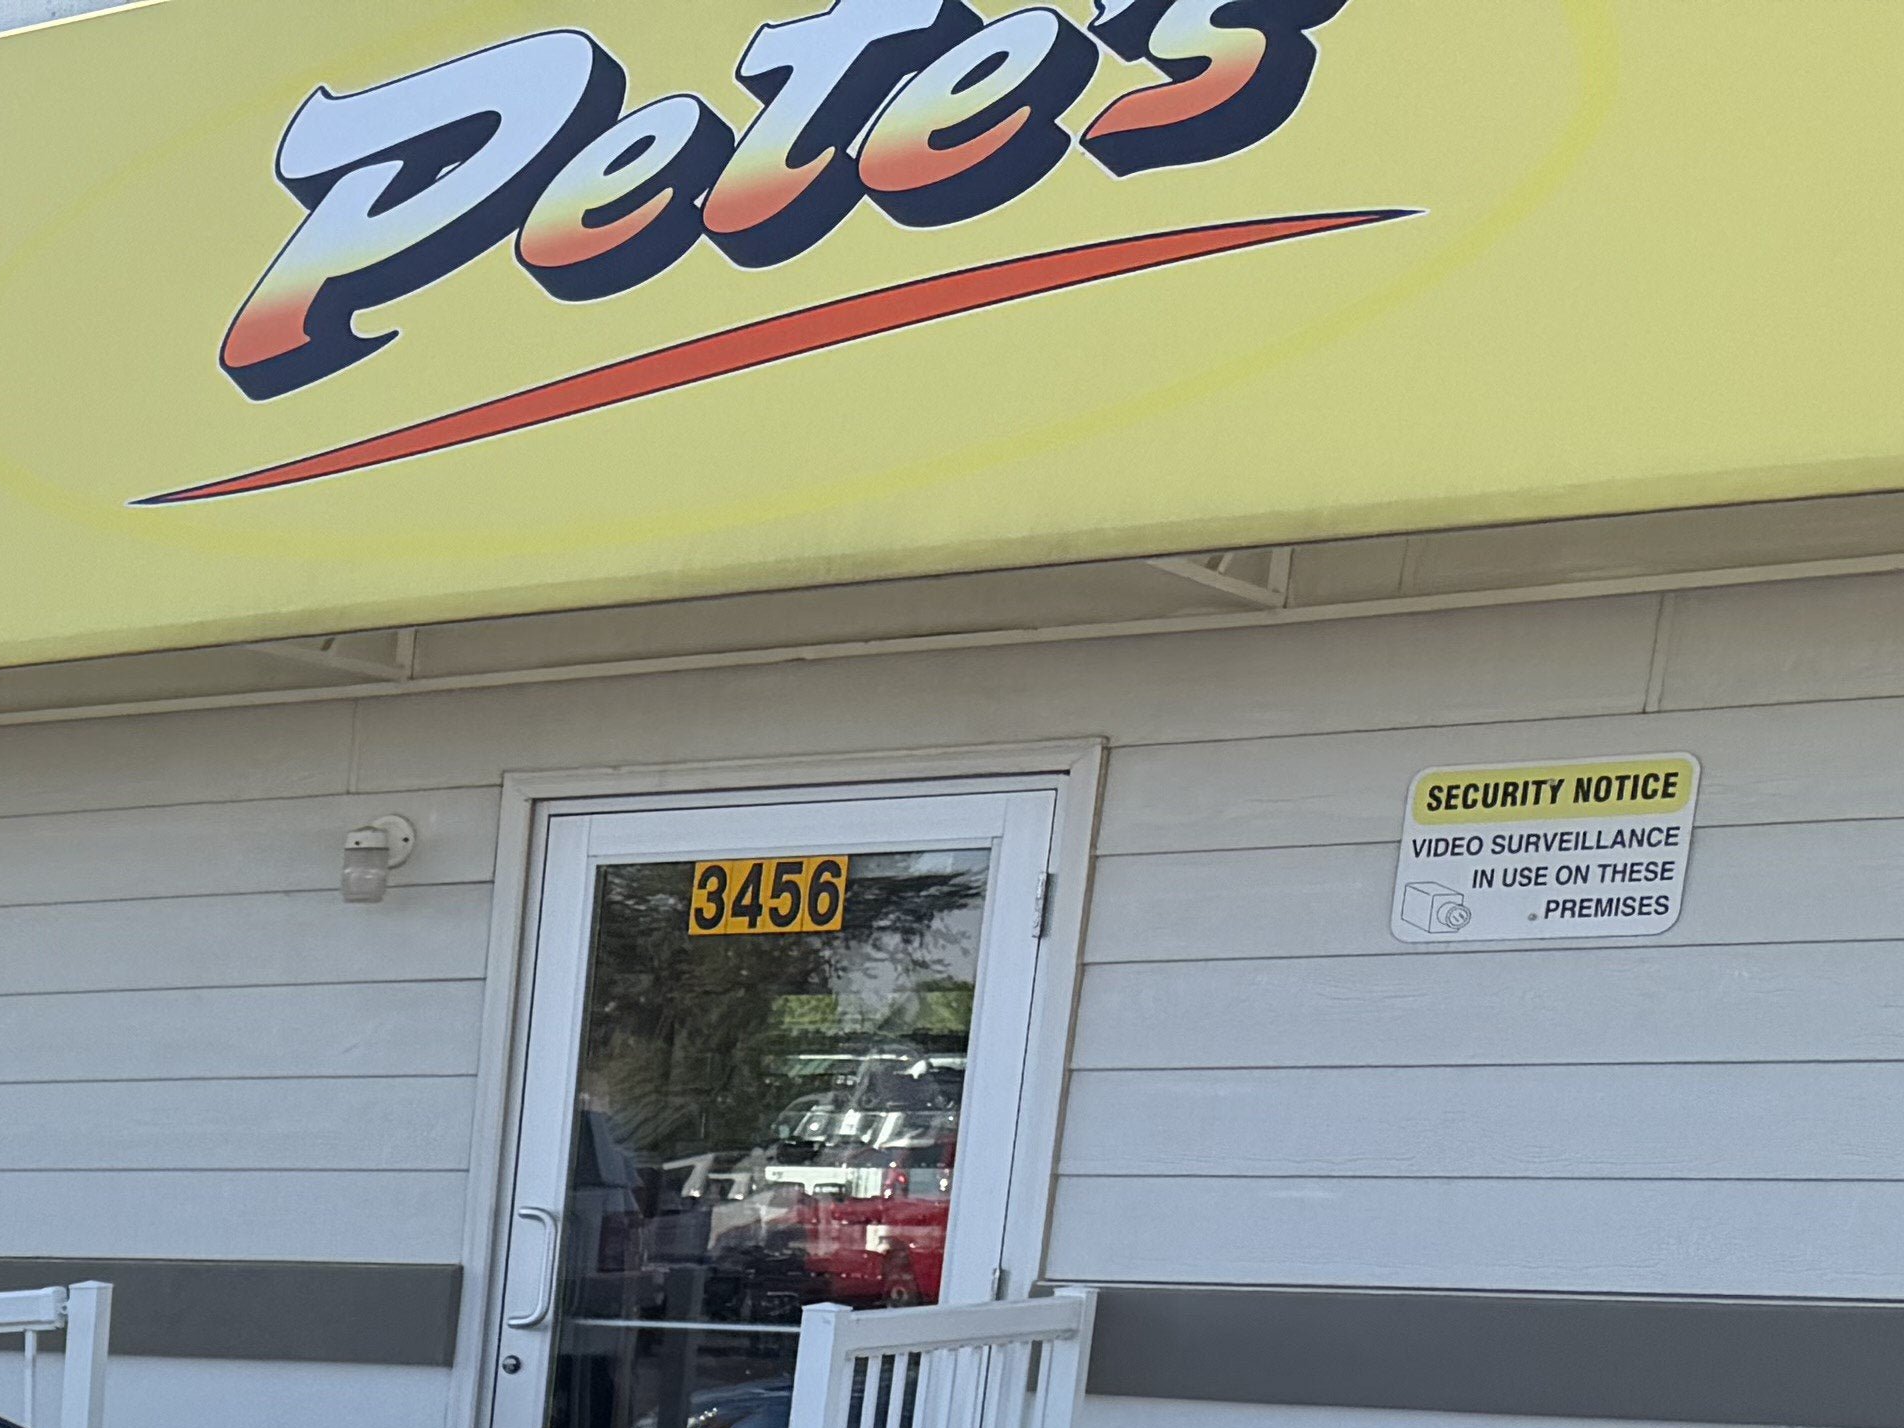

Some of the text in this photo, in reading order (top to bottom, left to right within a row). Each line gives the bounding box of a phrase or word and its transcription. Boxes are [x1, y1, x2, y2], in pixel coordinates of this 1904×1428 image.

[1426, 771, 1679, 812] SECURITY NOTICE
[1412, 826, 1681, 858] VIDEO SURVEILLANCE
[1472, 860, 1676, 889] IN USE ON THESE
[694, 859, 842, 931] 3456
[1544, 895, 1670, 920] PREMISES
